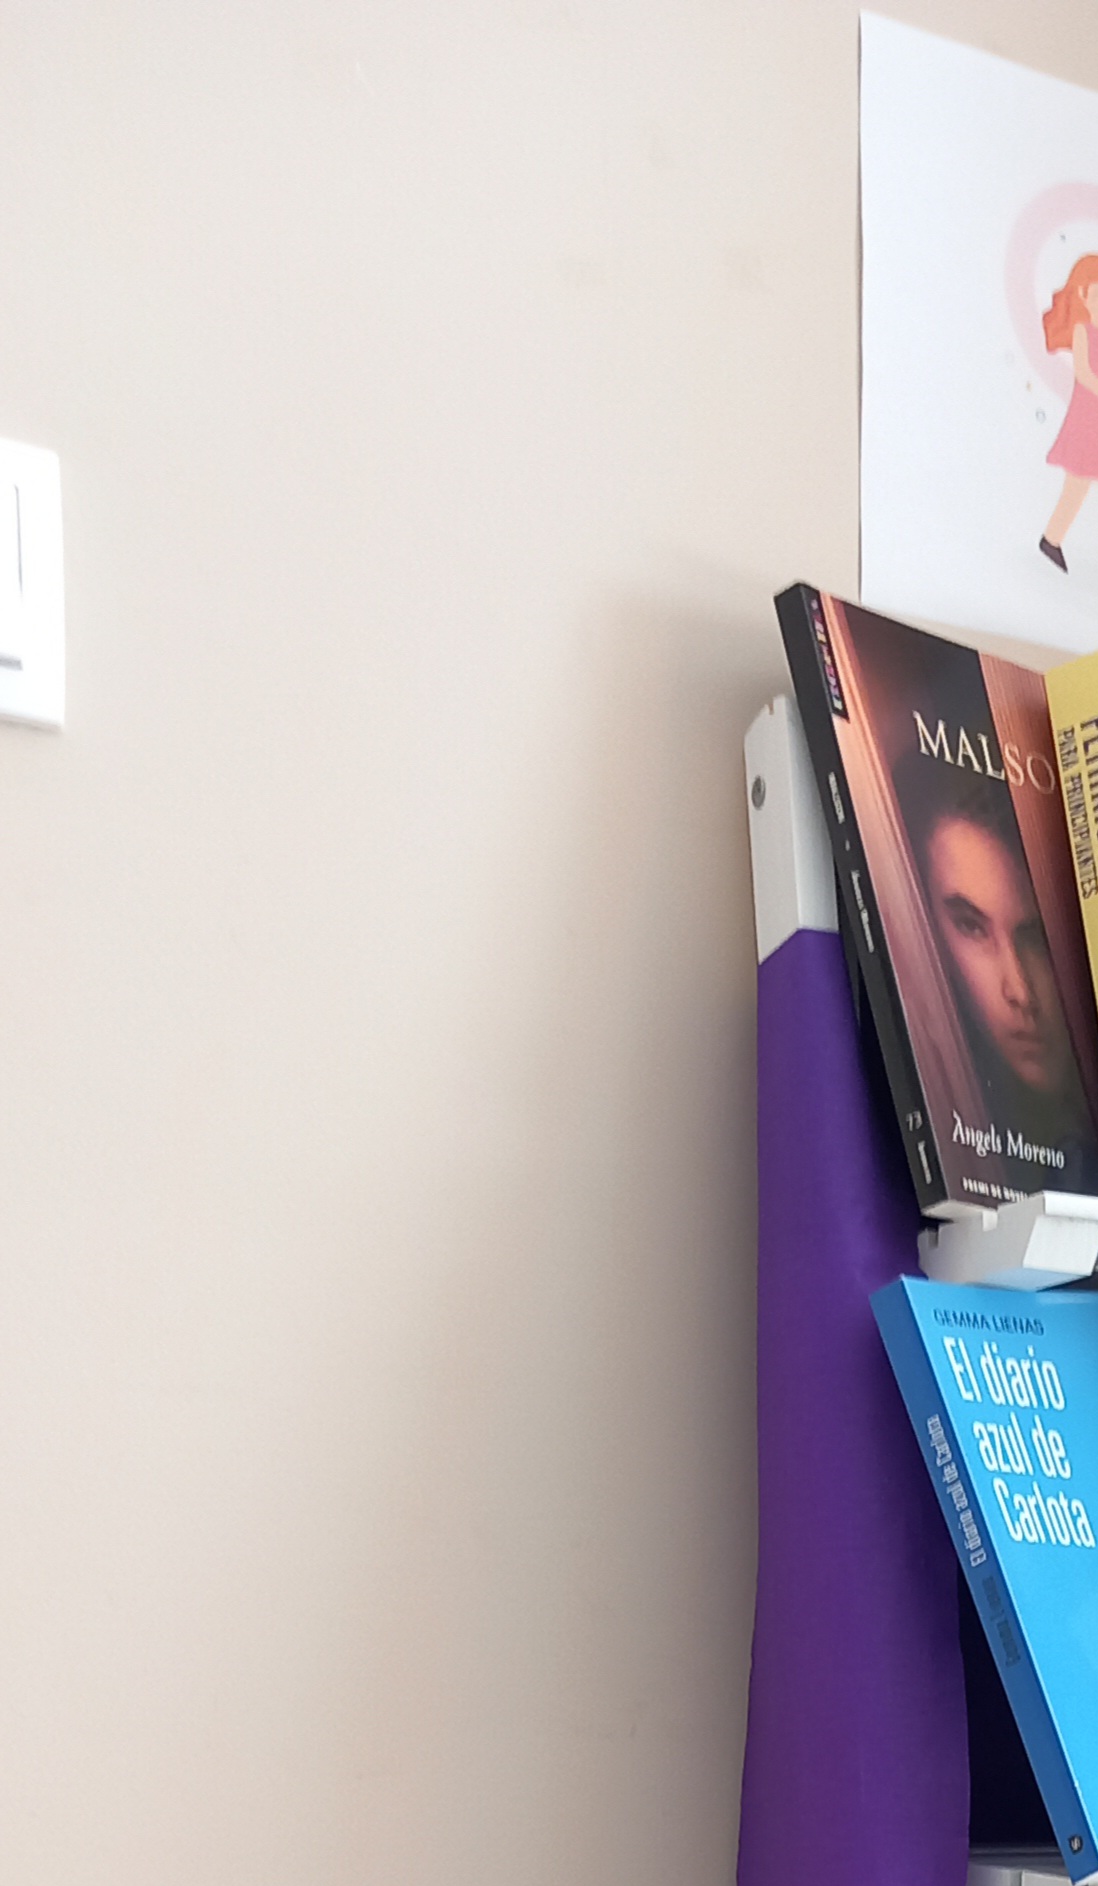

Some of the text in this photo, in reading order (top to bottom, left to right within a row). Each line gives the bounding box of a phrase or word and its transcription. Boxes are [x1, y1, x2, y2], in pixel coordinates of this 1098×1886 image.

[952, 1108, 1002, 1158] Àngels
[1006, 1128, 1066, 1169] Moreno
[933, 1308, 991, 1331] GEMMA
[943, 1335, 1066, 1412] El diario
[973, 1411, 1072, 1479] azul de
[993, 1477, 1096, 1548] Carlota
